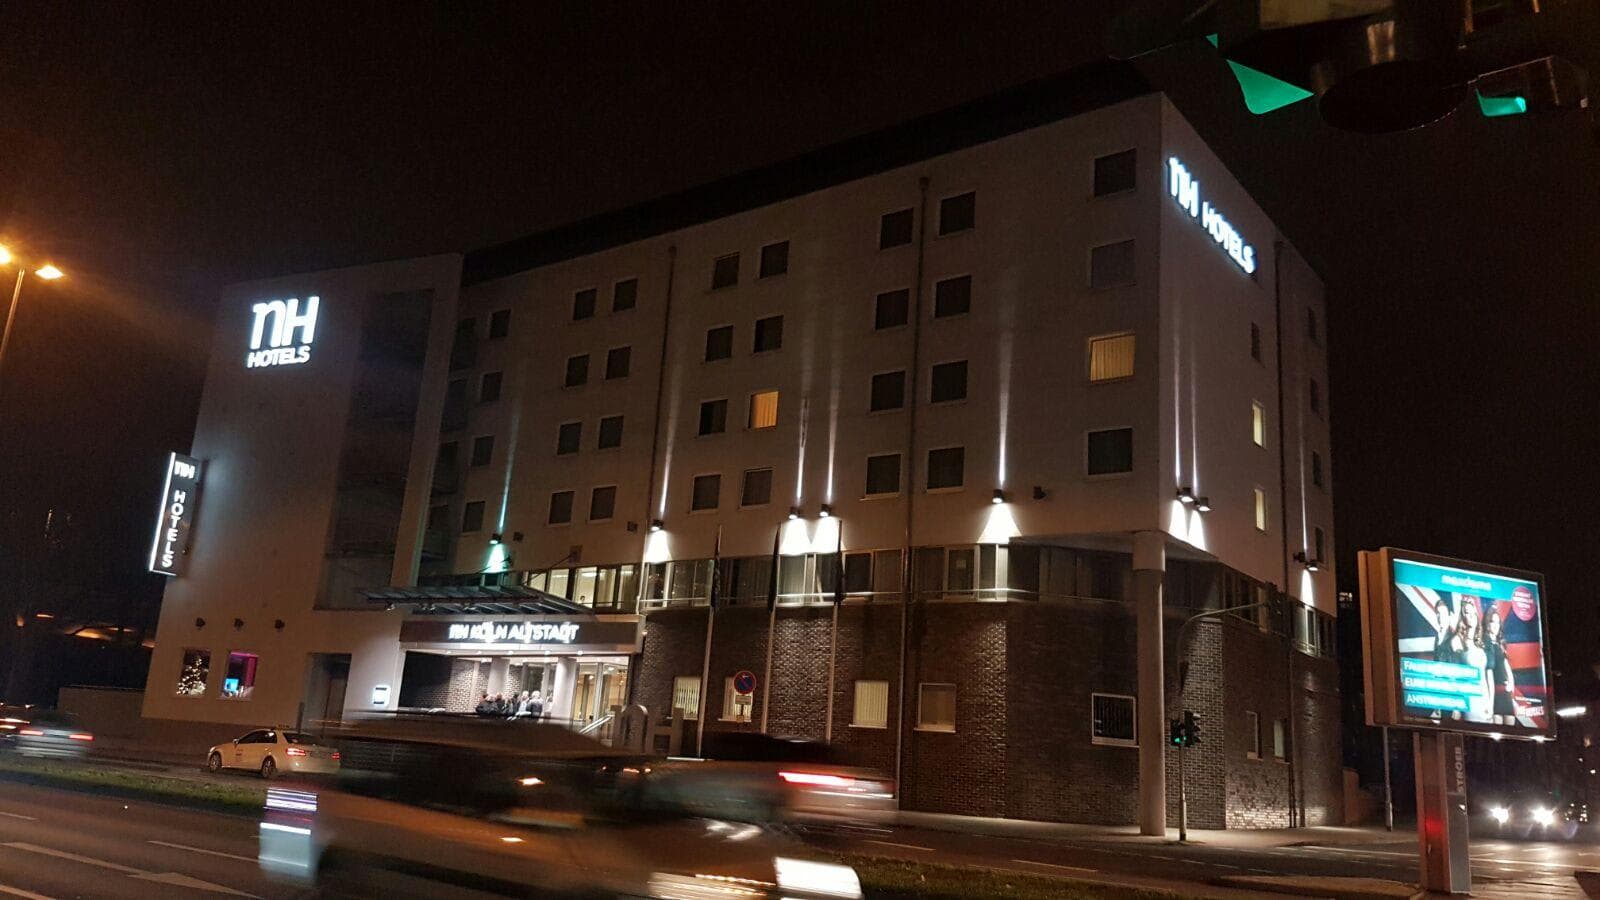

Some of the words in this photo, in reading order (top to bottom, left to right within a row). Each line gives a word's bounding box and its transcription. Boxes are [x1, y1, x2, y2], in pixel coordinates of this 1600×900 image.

[1202, 201, 1256, 274] HOTELS
[247, 345, 311, 368] HOTELS
[162, 490, 186, 568] HOTELS
